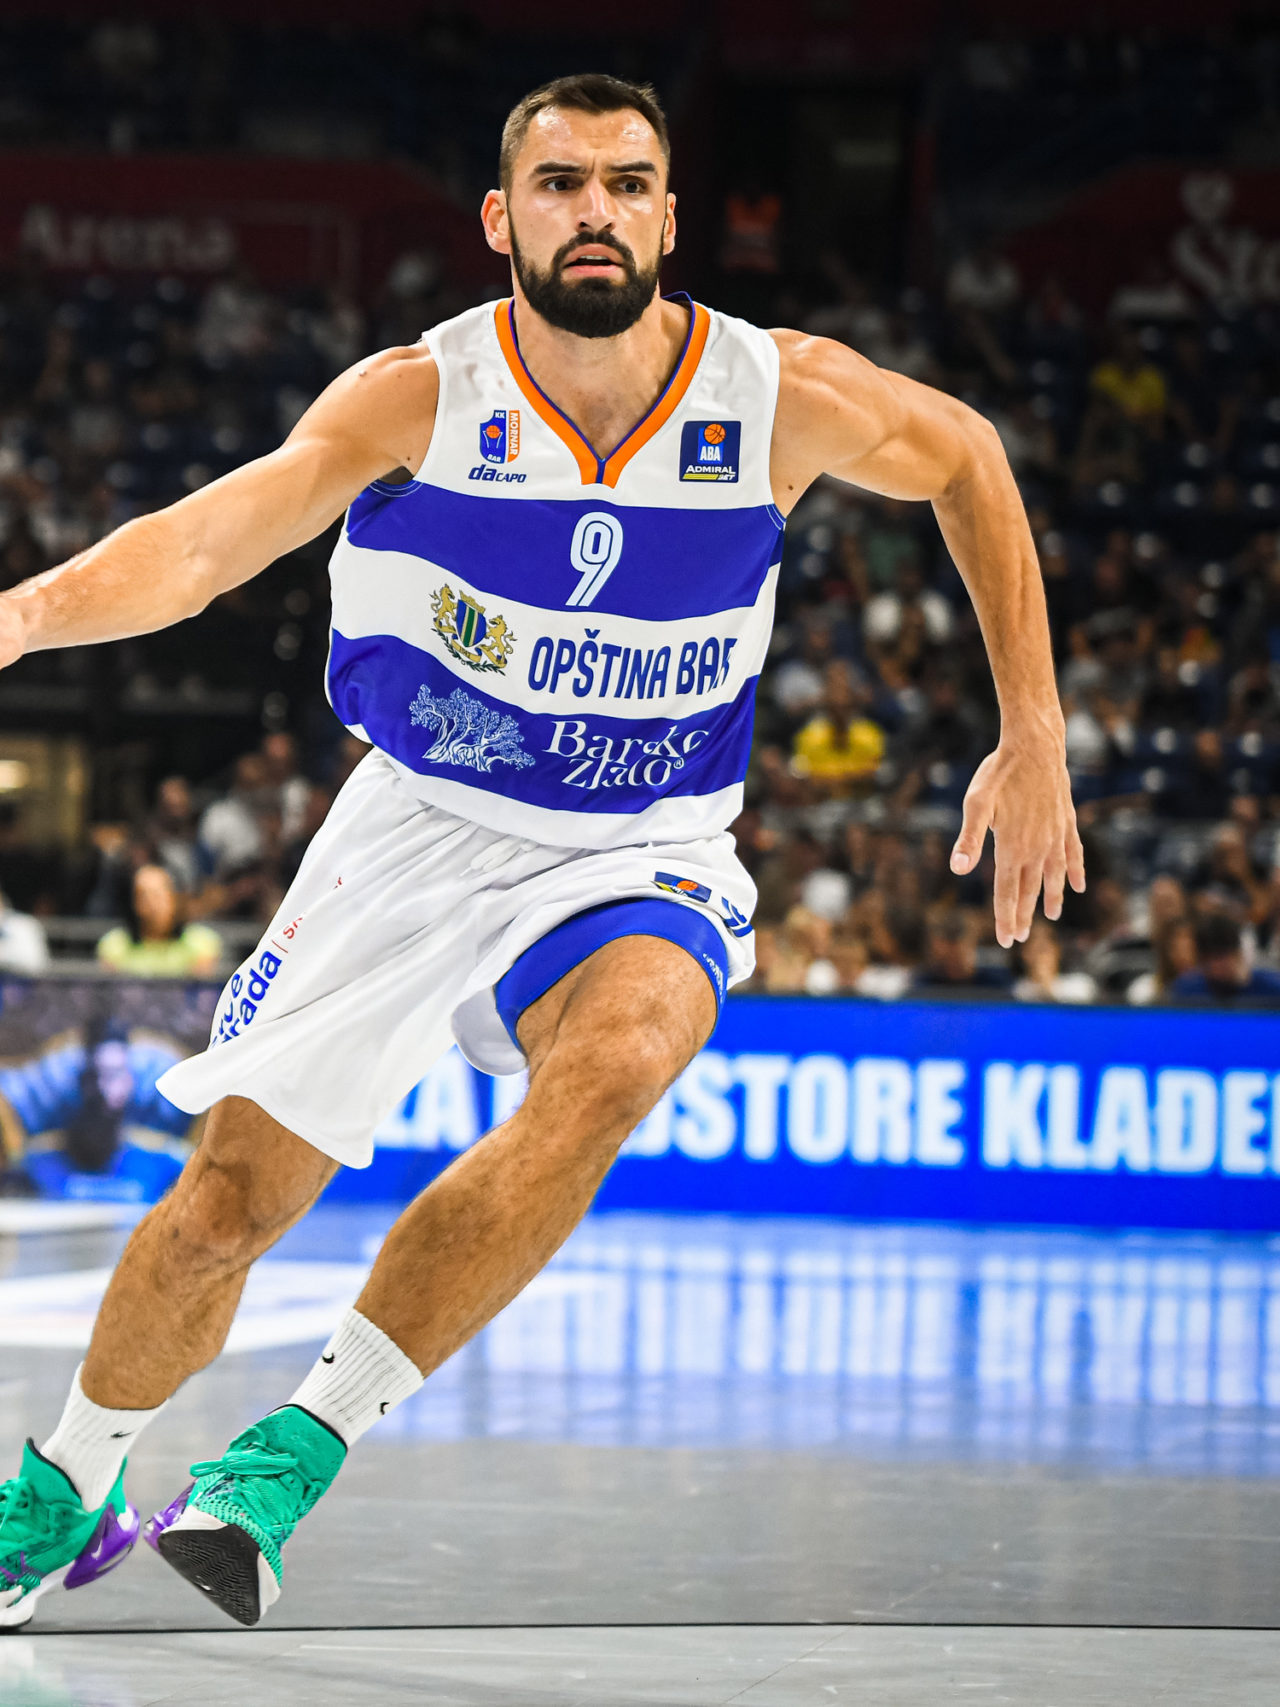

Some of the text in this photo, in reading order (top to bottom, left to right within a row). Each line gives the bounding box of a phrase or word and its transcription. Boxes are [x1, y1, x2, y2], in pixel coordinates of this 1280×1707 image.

[510, 412, 519, 455] MORNAR
[700, 446, 721, 461] ABA
[685, 464, 736, 475] ADMIRAL
[565, 511, 624, 607] 9
[527, 628, 672, 700] OPŠTINA
